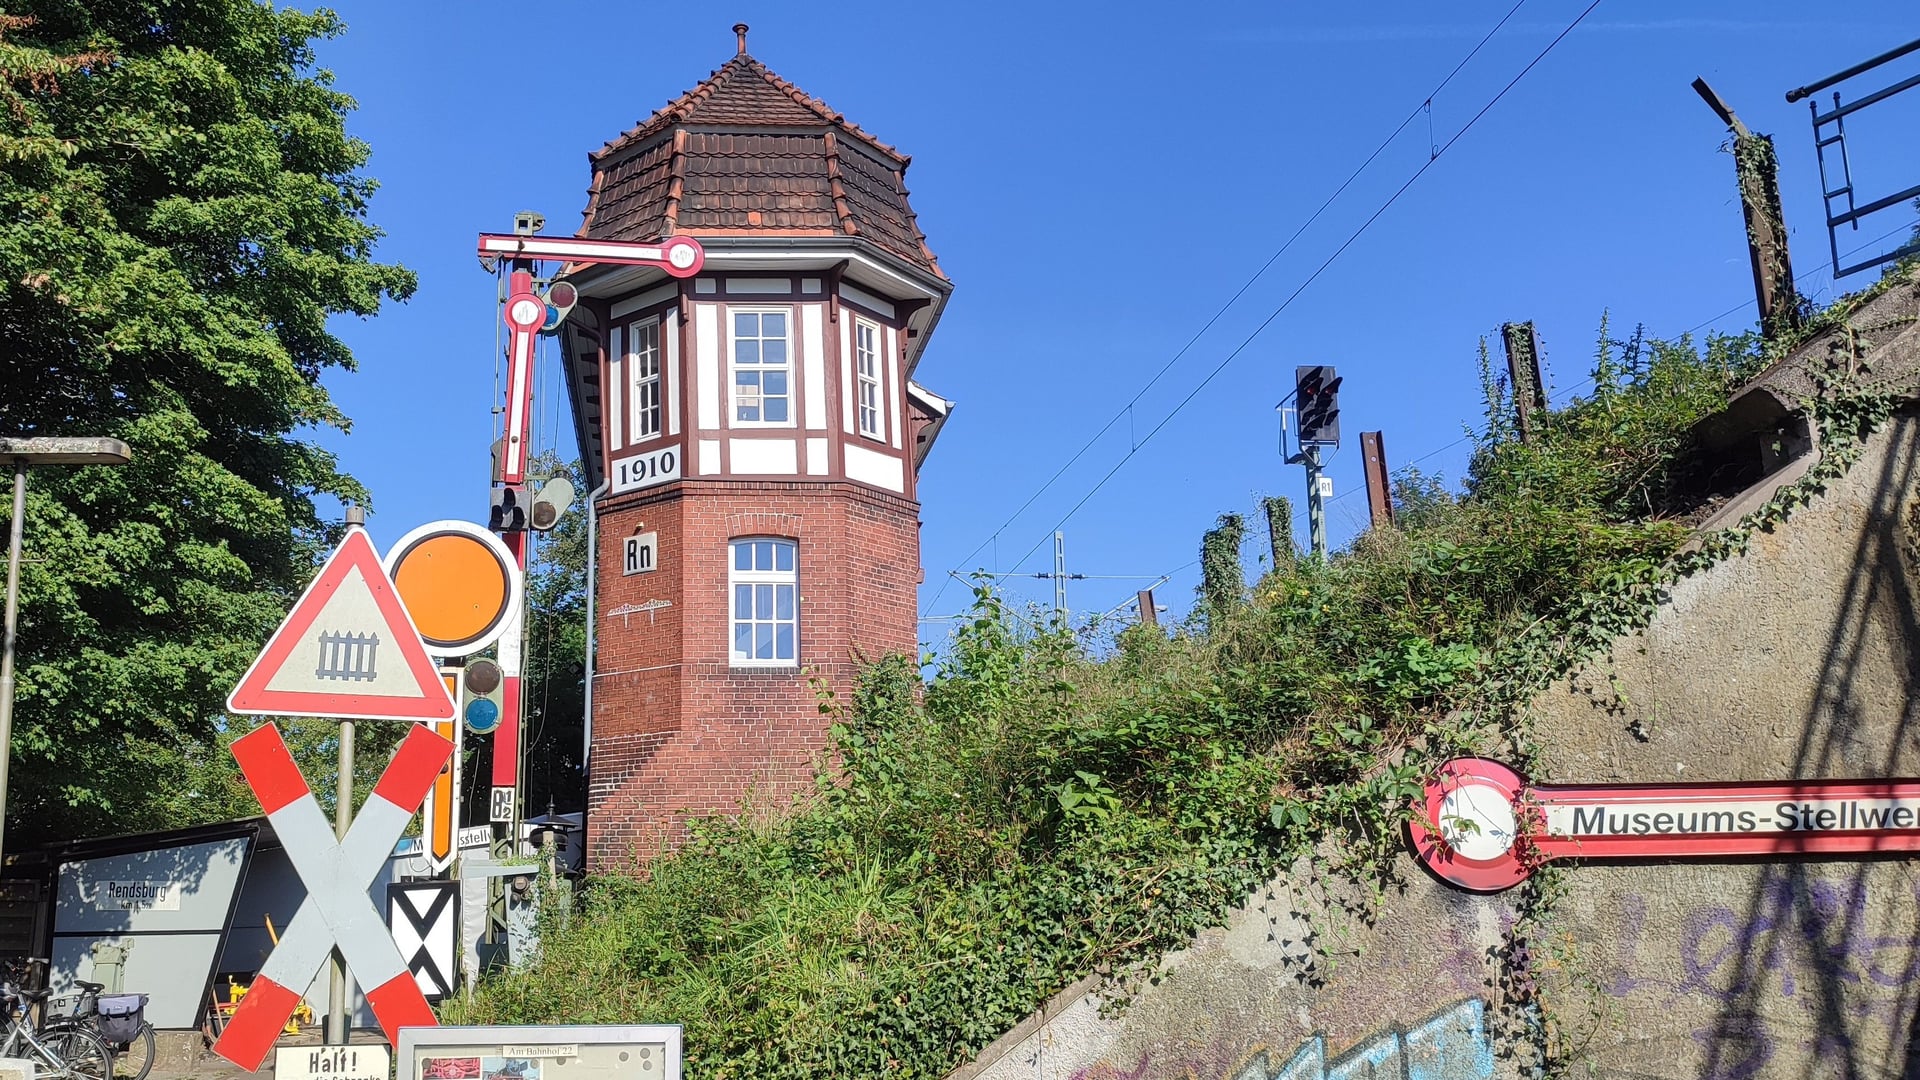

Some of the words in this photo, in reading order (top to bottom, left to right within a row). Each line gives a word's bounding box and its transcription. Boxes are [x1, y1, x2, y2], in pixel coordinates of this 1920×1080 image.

[620, 451, 675, 485] 1910
[1321, 482, 1331, 493] R1
[627, 539, 651, 571] Rn
[108, 881, 167, 902] Rendsburg
[121, 899, 132, 909] km
[509, 1047, 524, 1056] Am
[526, 1046, 560, 1056] Bahnhof
[562, 1046, 573, 1055] 22
[309, 1051, 357, 1073] Halt!
